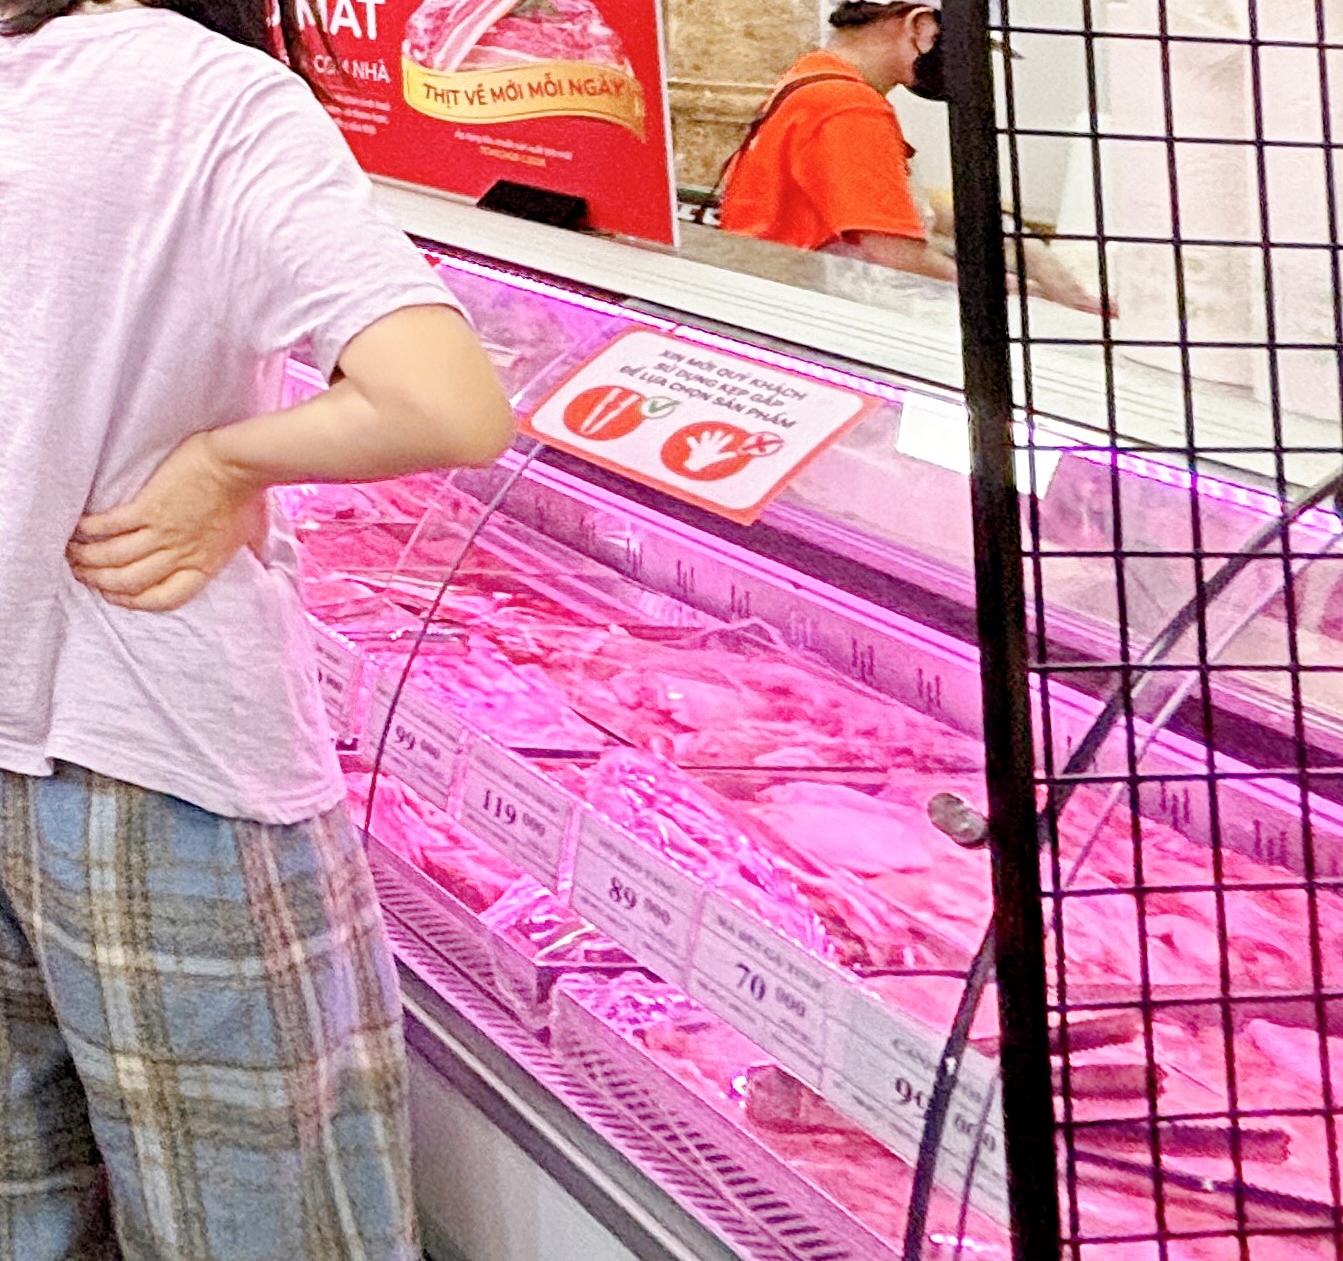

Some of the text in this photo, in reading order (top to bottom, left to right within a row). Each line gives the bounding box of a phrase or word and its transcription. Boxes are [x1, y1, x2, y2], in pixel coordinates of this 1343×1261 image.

[423, 83, 460, 109] THỊT
[527, 72, 565, 97] MỖI
[568, 74, 626, 99] NGÀY
[750, 377, 808, 401] KHÁCH
[483, 788, 517, 825] 119
[609, 876, 638, 910] 89
[736, 962, 767, 1002] 70
